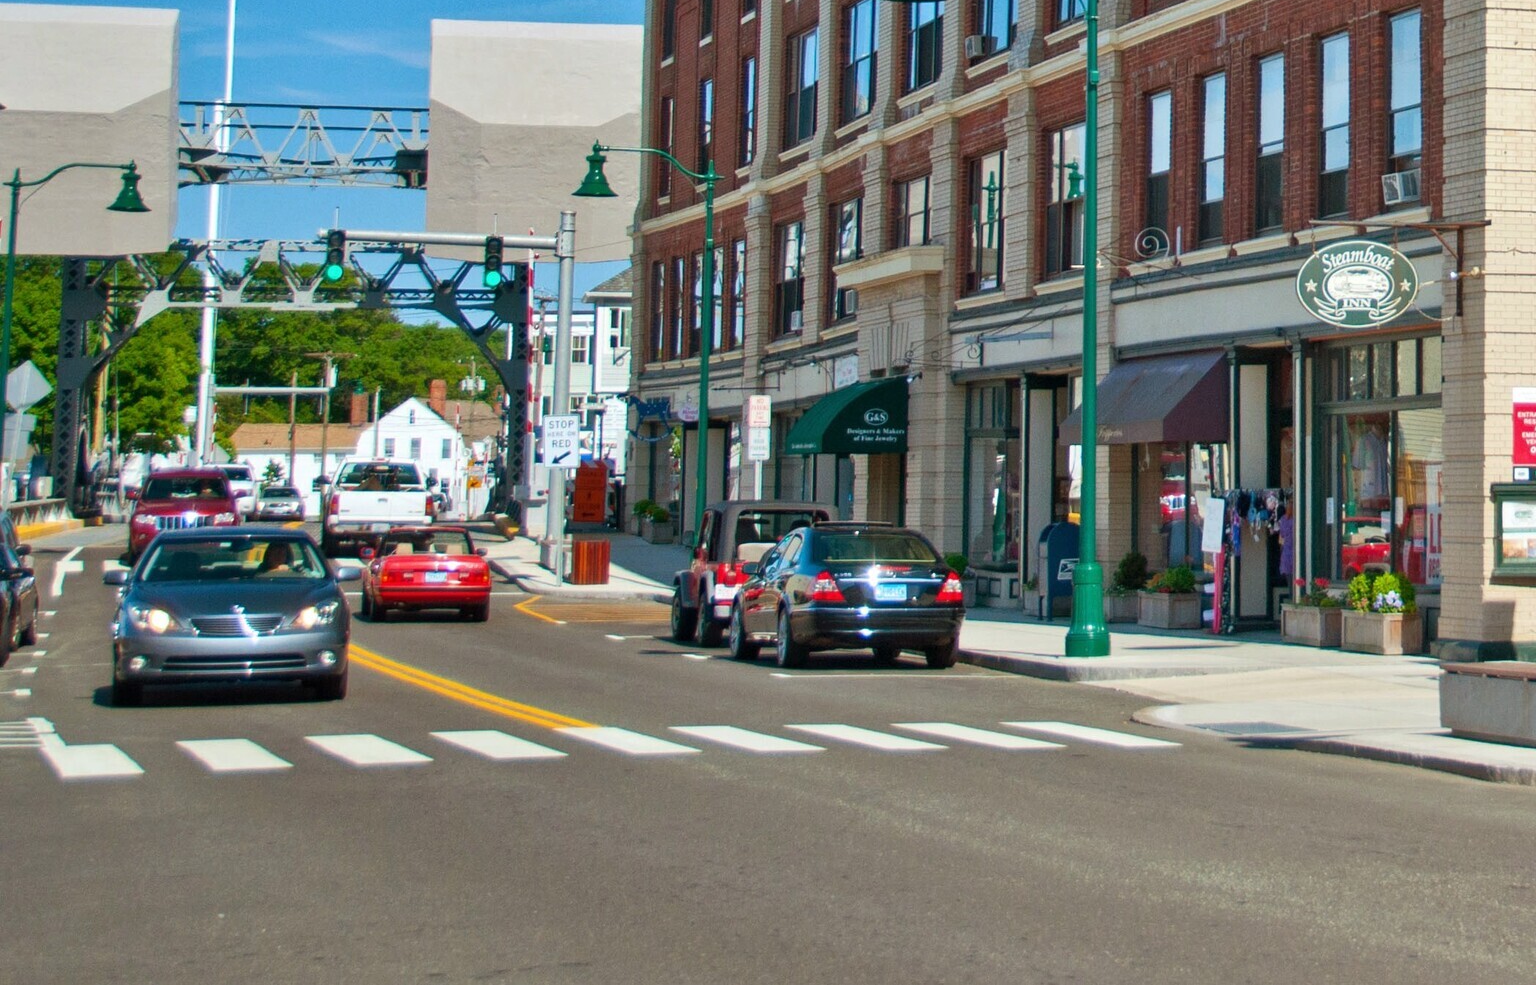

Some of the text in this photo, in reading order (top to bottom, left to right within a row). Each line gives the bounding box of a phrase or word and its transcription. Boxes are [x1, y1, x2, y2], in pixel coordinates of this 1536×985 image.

[1322, 245, 1395, 273] Steamboat
[1342, 298, 1372, 308] INN
[865, 412, 886, 422] G&S
[549, 419, 574, 430] STOP
[552, 439, 572, 448] RED
